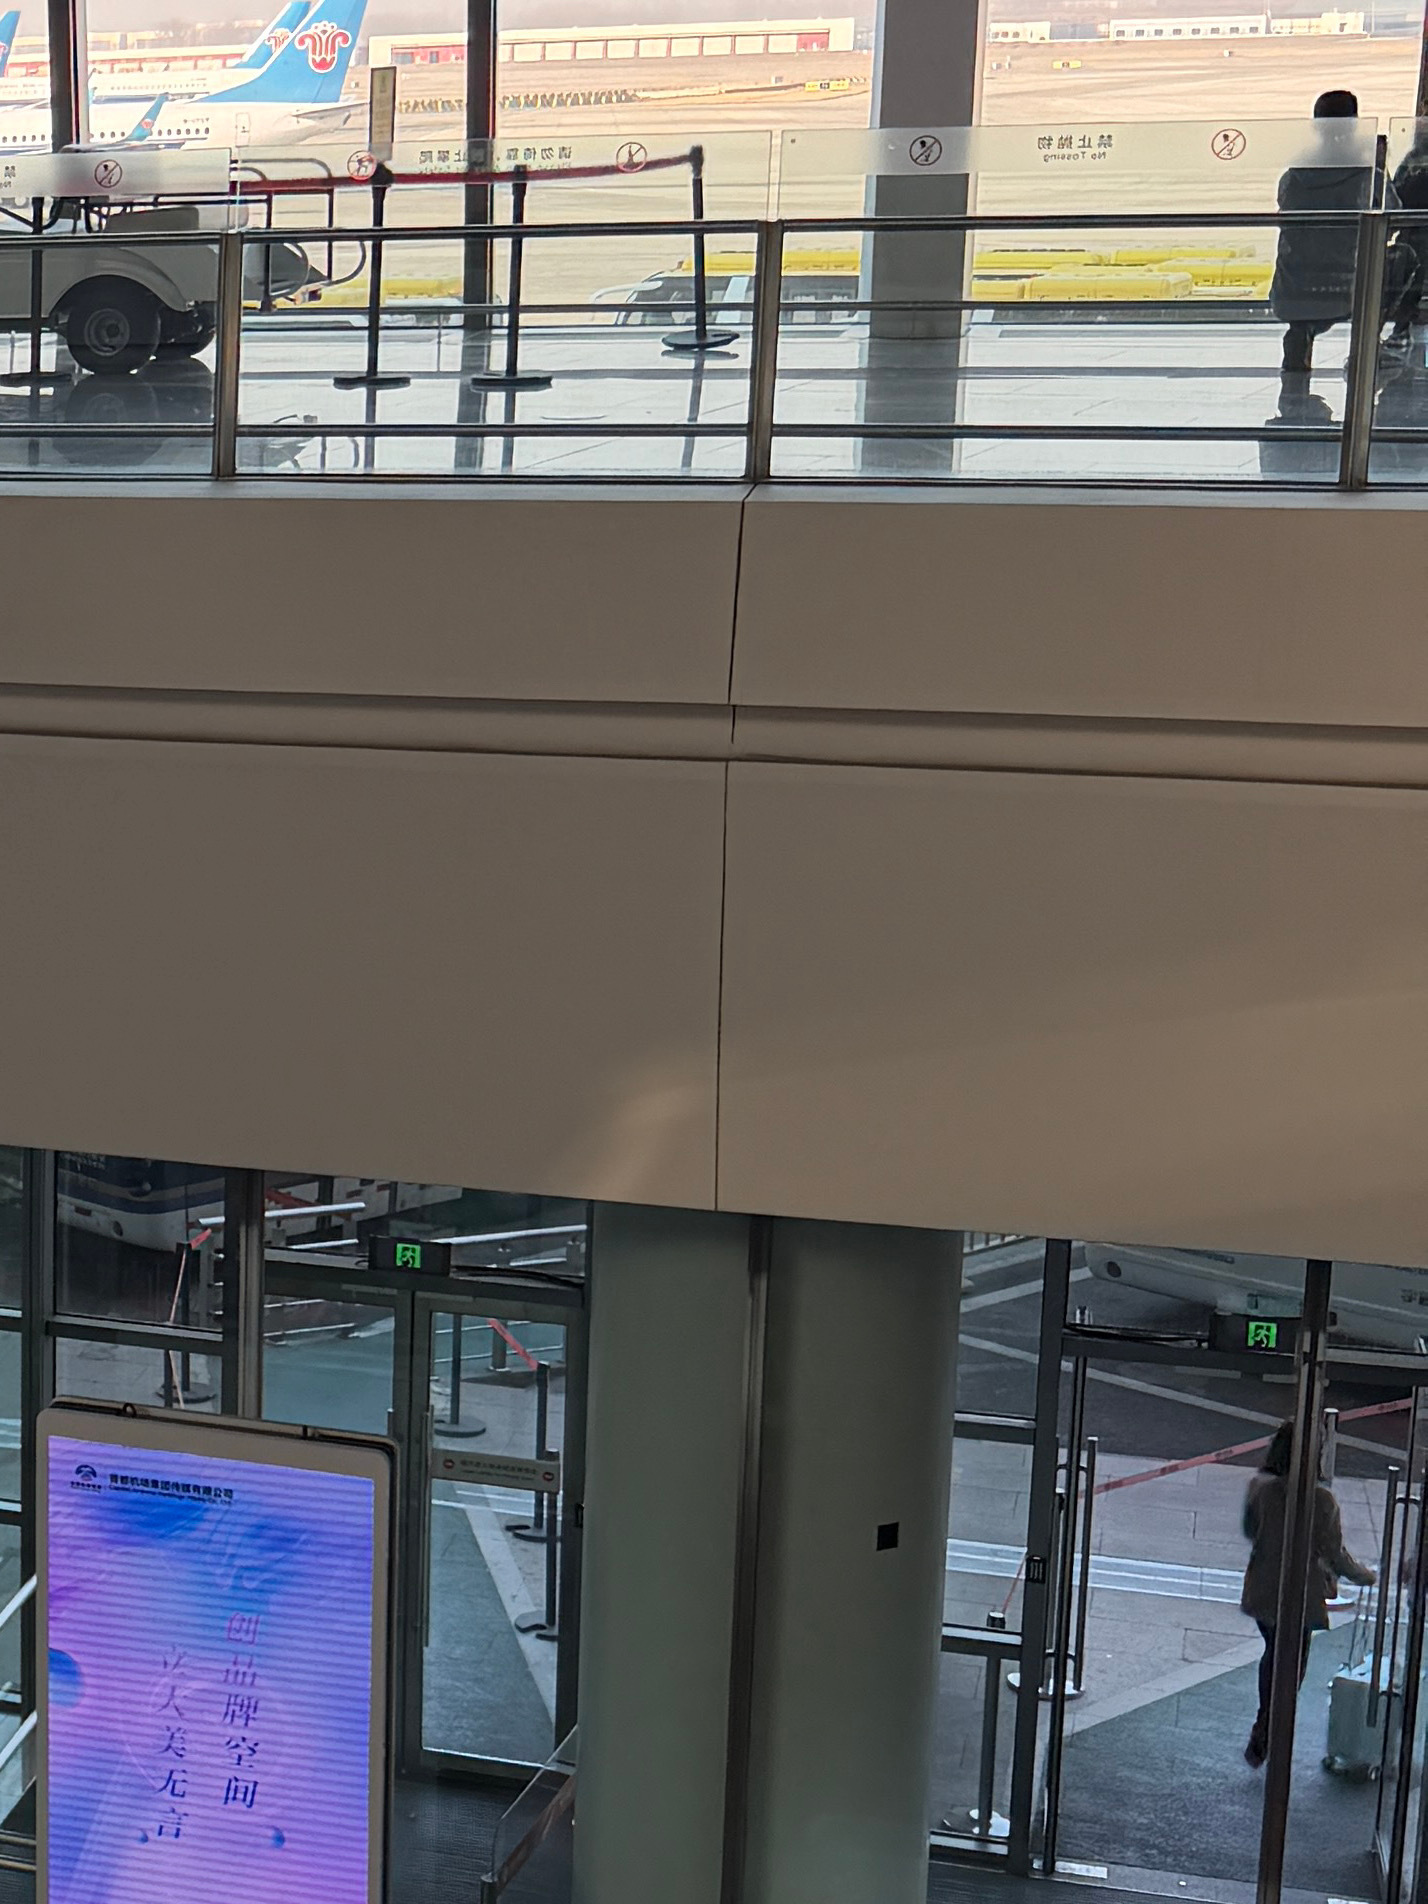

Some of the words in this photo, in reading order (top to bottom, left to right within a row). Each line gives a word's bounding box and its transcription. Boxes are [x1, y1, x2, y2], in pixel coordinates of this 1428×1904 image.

[223, 1612, 260, 1809] 创品牌空间
